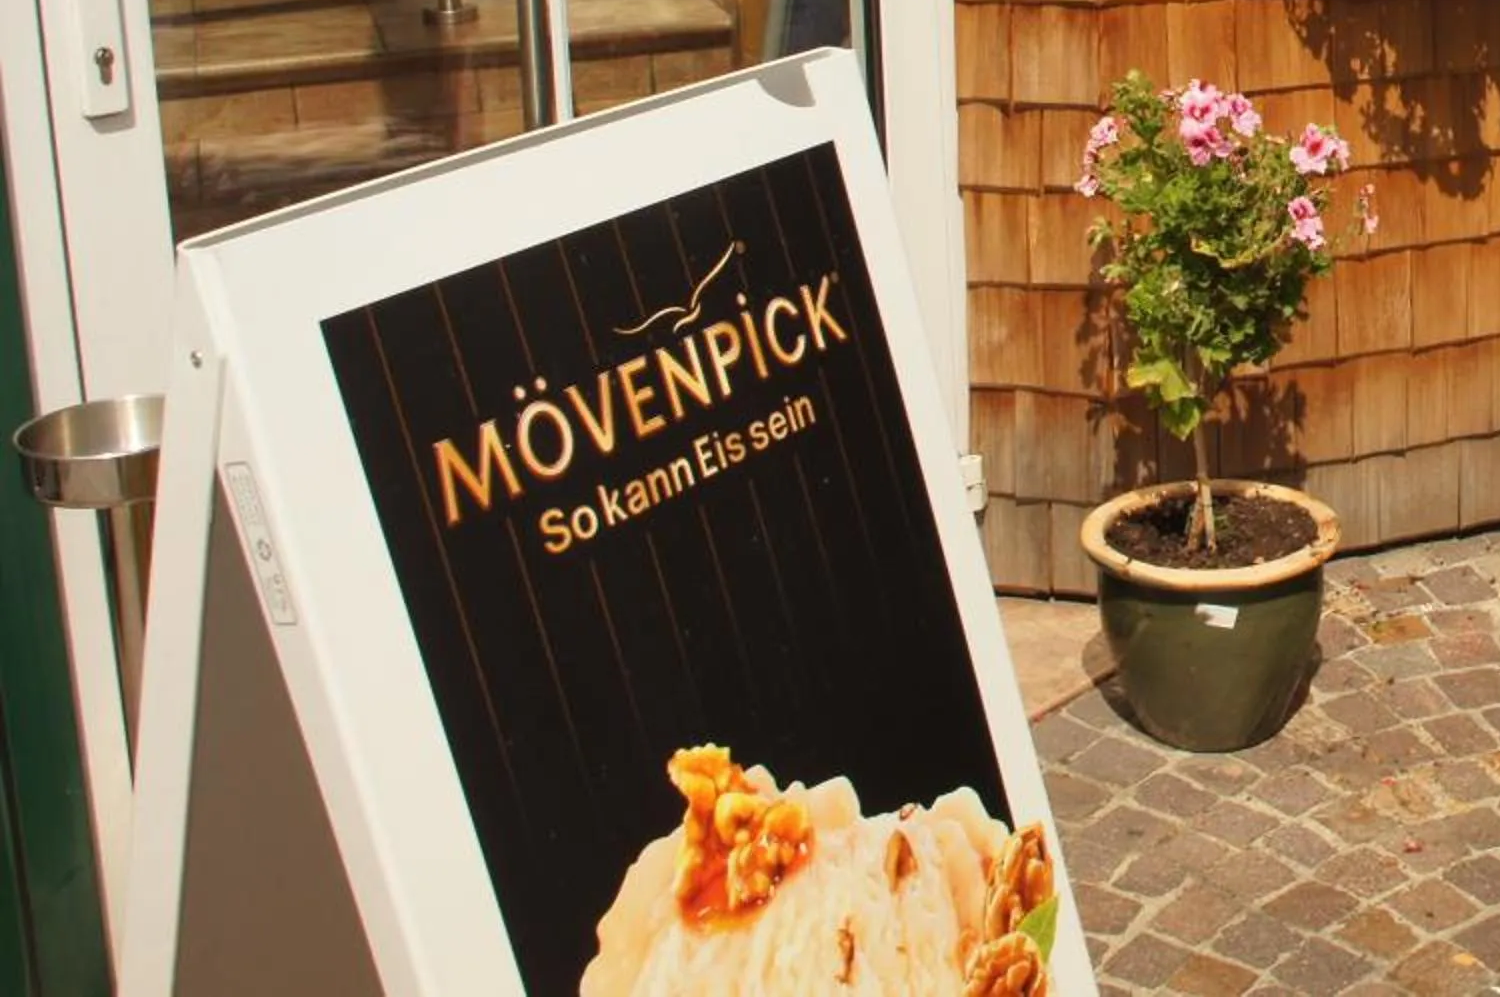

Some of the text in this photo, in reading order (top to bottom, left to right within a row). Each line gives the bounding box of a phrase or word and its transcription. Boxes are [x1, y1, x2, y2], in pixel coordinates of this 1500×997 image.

[539, 395, 816, 554] So kann Eis sein
